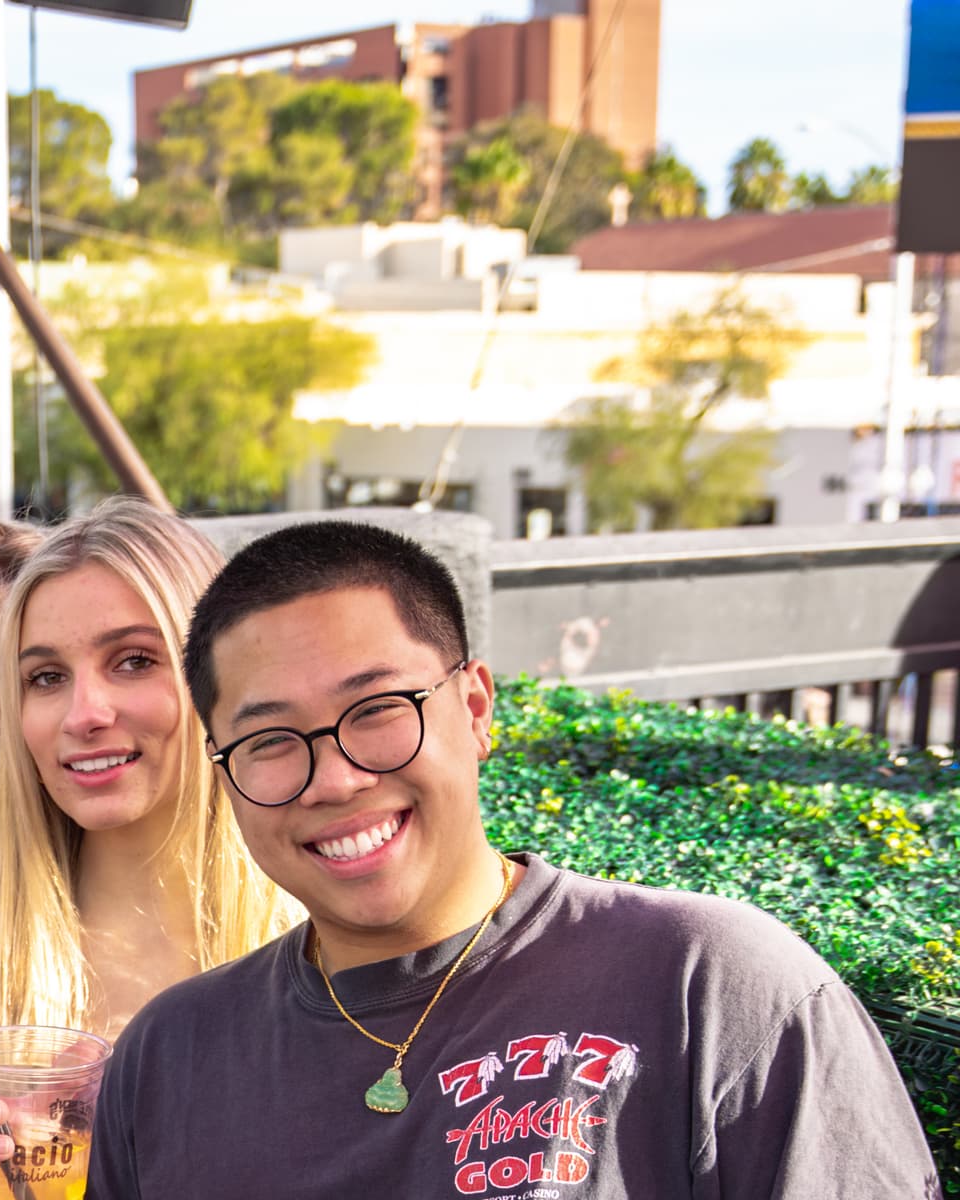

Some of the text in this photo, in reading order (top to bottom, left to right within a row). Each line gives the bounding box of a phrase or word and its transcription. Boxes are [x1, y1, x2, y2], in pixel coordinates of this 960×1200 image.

[446, 1095, 607, 1165] APACHE
[12, 1135, 74, 1167] acio
[454, 1151, 589, 1194] GOLD
[523, 1188, 560, 1200] CASINO
